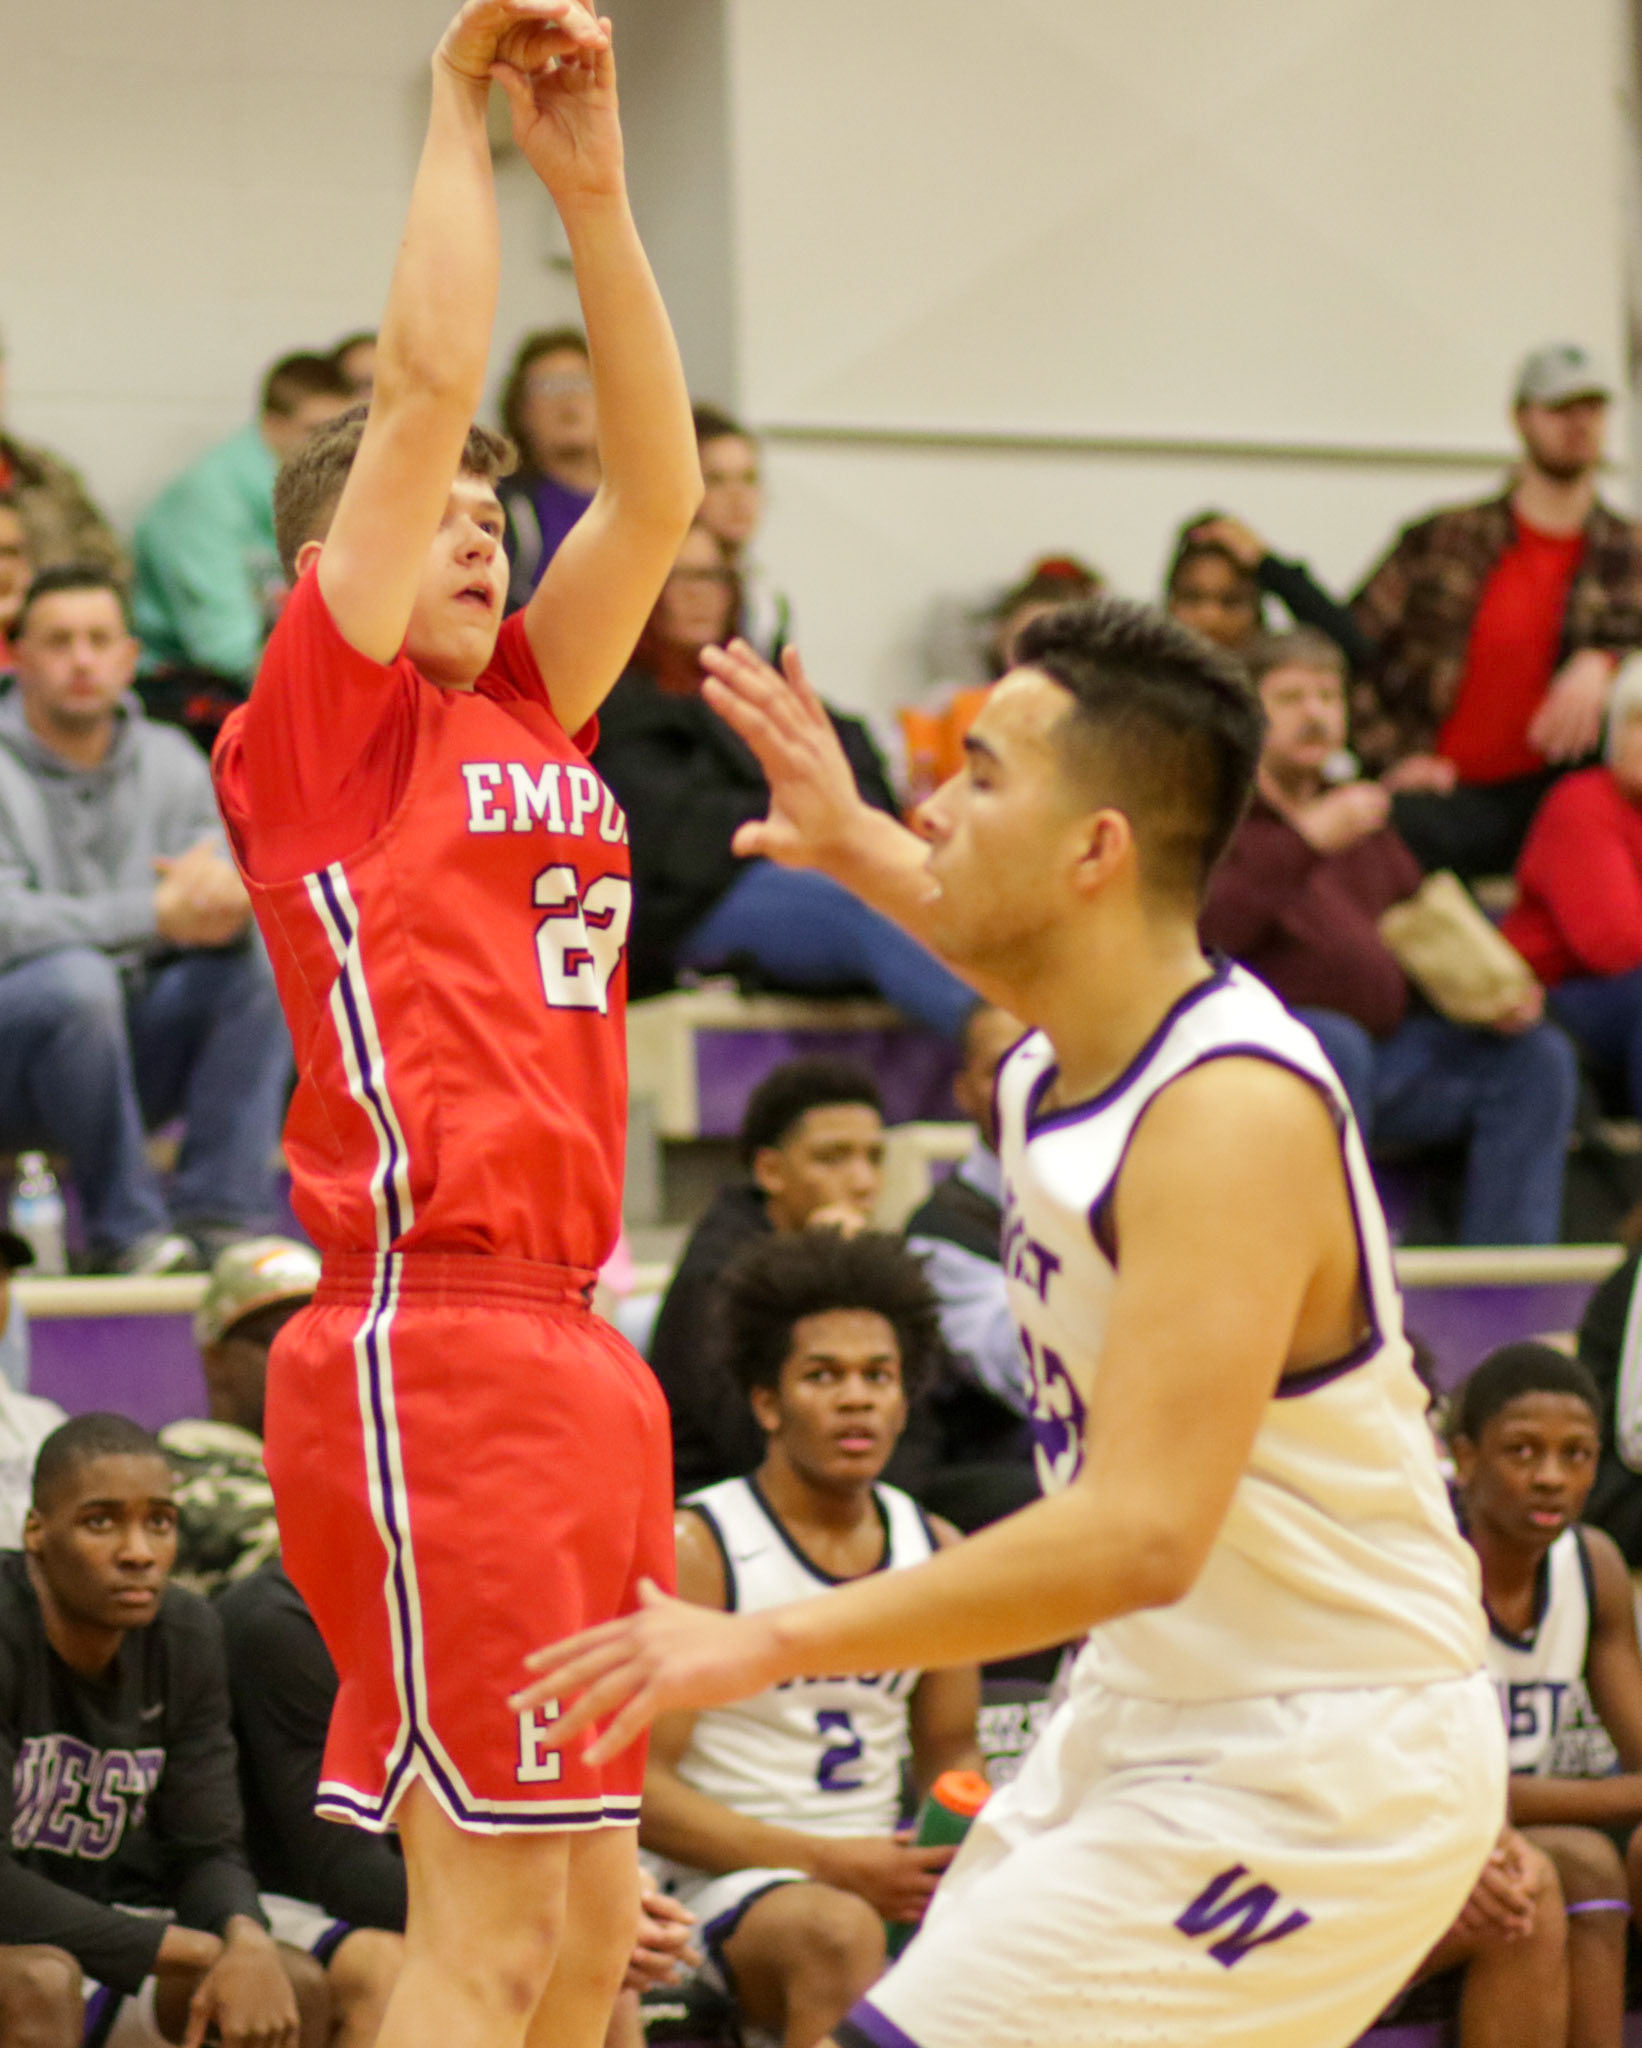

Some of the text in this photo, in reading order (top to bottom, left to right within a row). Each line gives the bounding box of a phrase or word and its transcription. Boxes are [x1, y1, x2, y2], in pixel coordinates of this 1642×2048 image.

[461, 762, 629, 845] EMPO
[511, 1689, 562, 1785] E
[816, 1709, 864, 1792] 2
[1173, 1862, 1313, 1971] W
